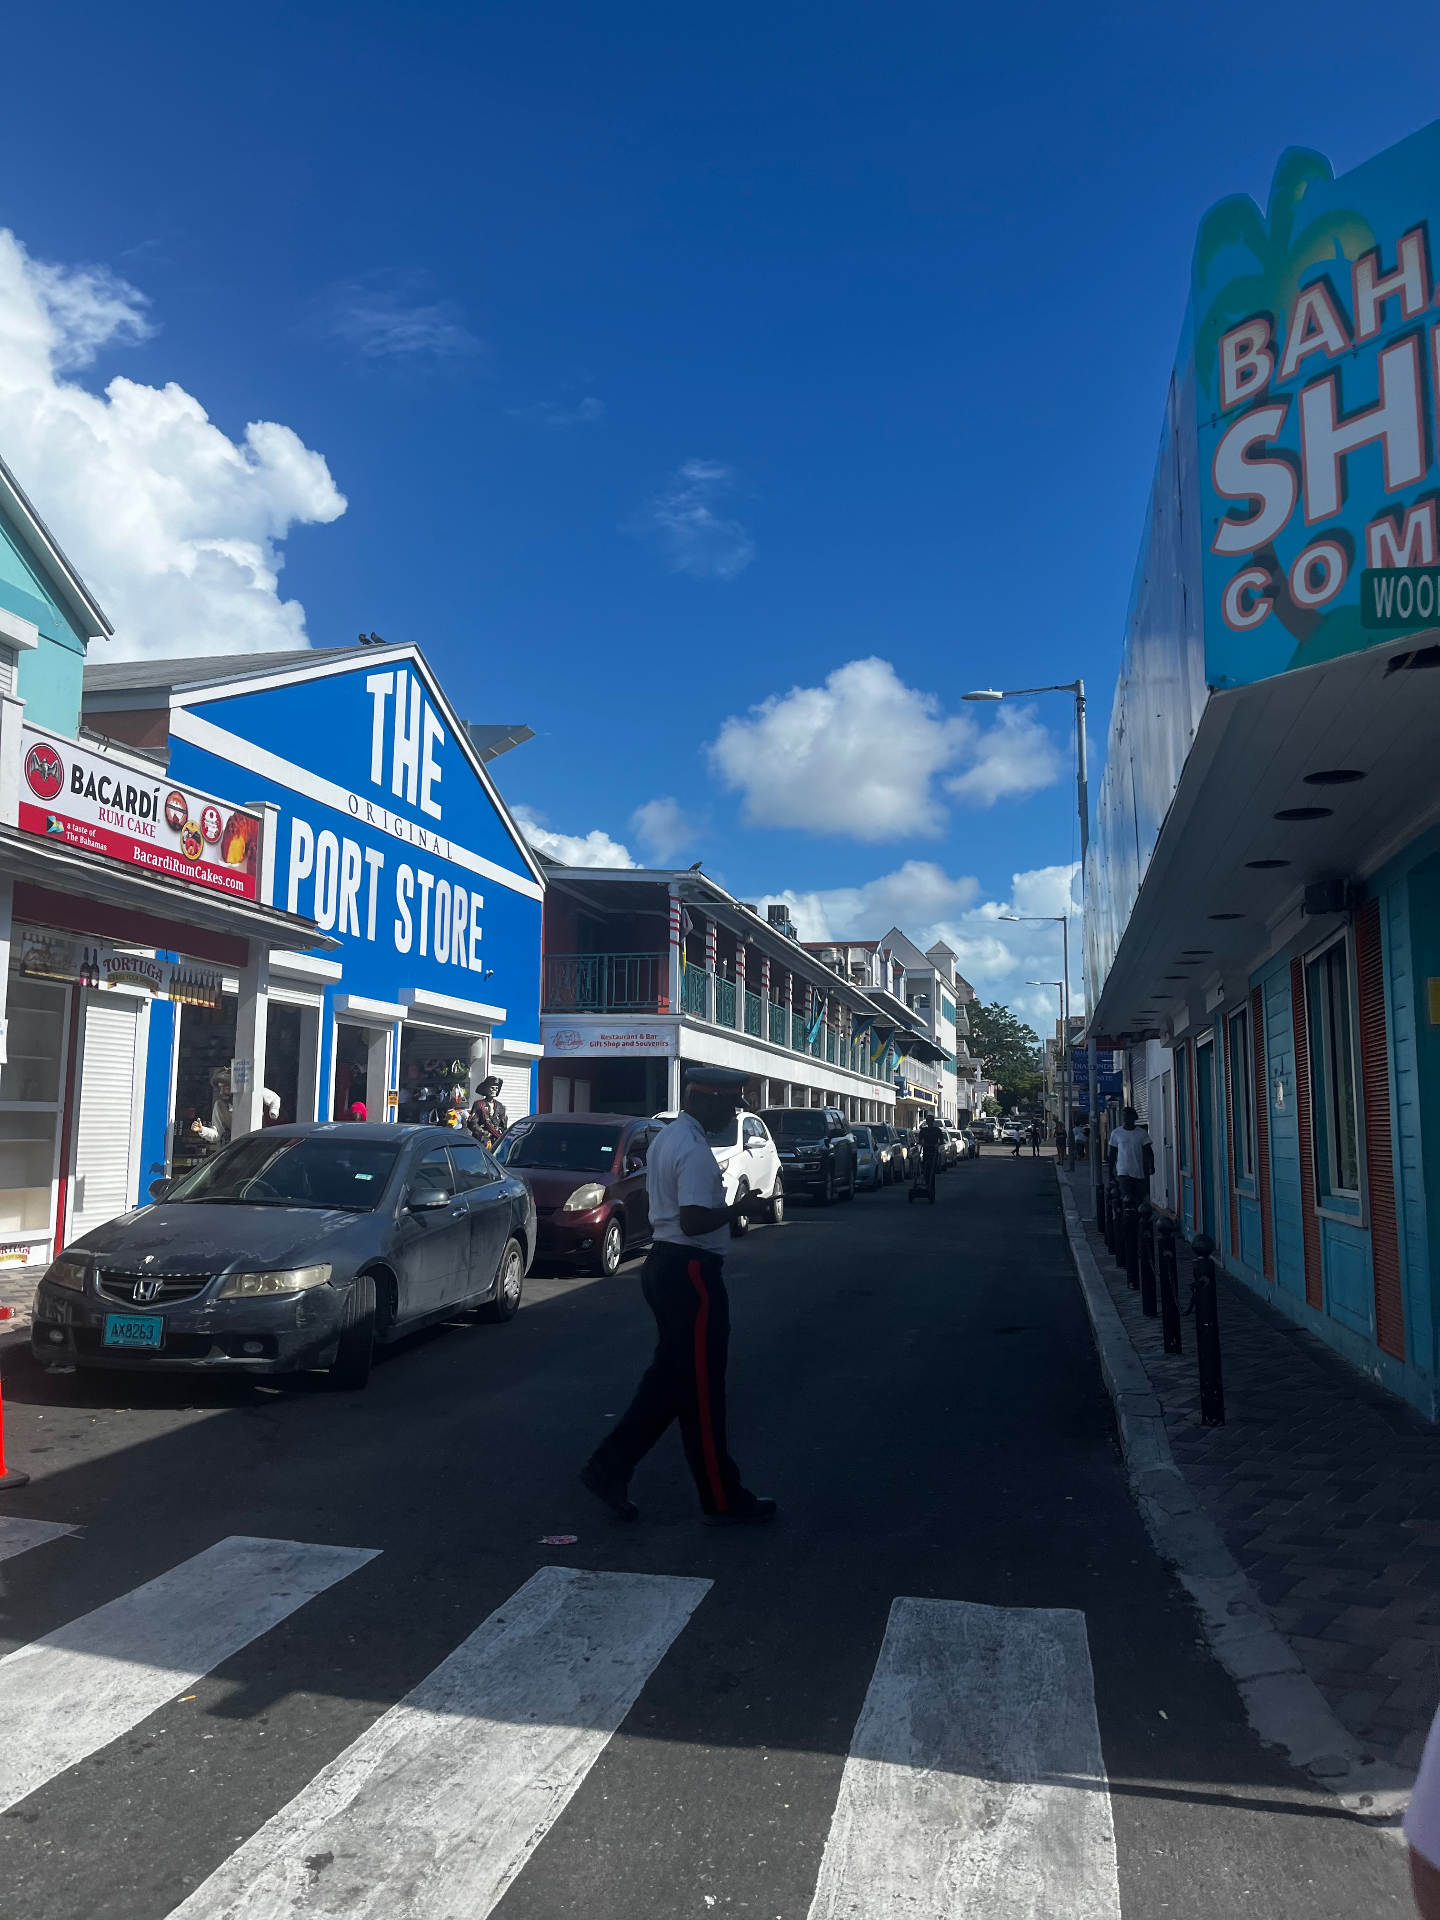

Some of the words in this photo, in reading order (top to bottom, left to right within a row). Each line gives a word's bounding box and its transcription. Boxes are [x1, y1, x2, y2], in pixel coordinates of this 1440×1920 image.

[1219, 228, 1440, 411] BAH
[1211, 324, 1440, 556] SH
[1373, 575, 1440, 618] WOO
[367, 670, 444, 820] THE
[70, 763, 160, 823] BACARDÍ
[66, 831, 79, 842] The
[79, 836, 108, 851] Bahamas
[72, 824, 88, 835] taste
[88, 828, 97, 838] of
[98, 806, 125, 828] RUM
[127, 817, 156, 839] CAKE
[348, 794, 453, 860] ORIGINAL
[133, 845, 244, 892] BacardiRumCakes.com
[287, 816, 384, 942] PORT
[394, 863, 484, 973] STORE
[103, 957, 163, 983] TORTUGA
[603, 1041, 620, 1049] Shop
[111, 1323, 154, 1339] AX8263
